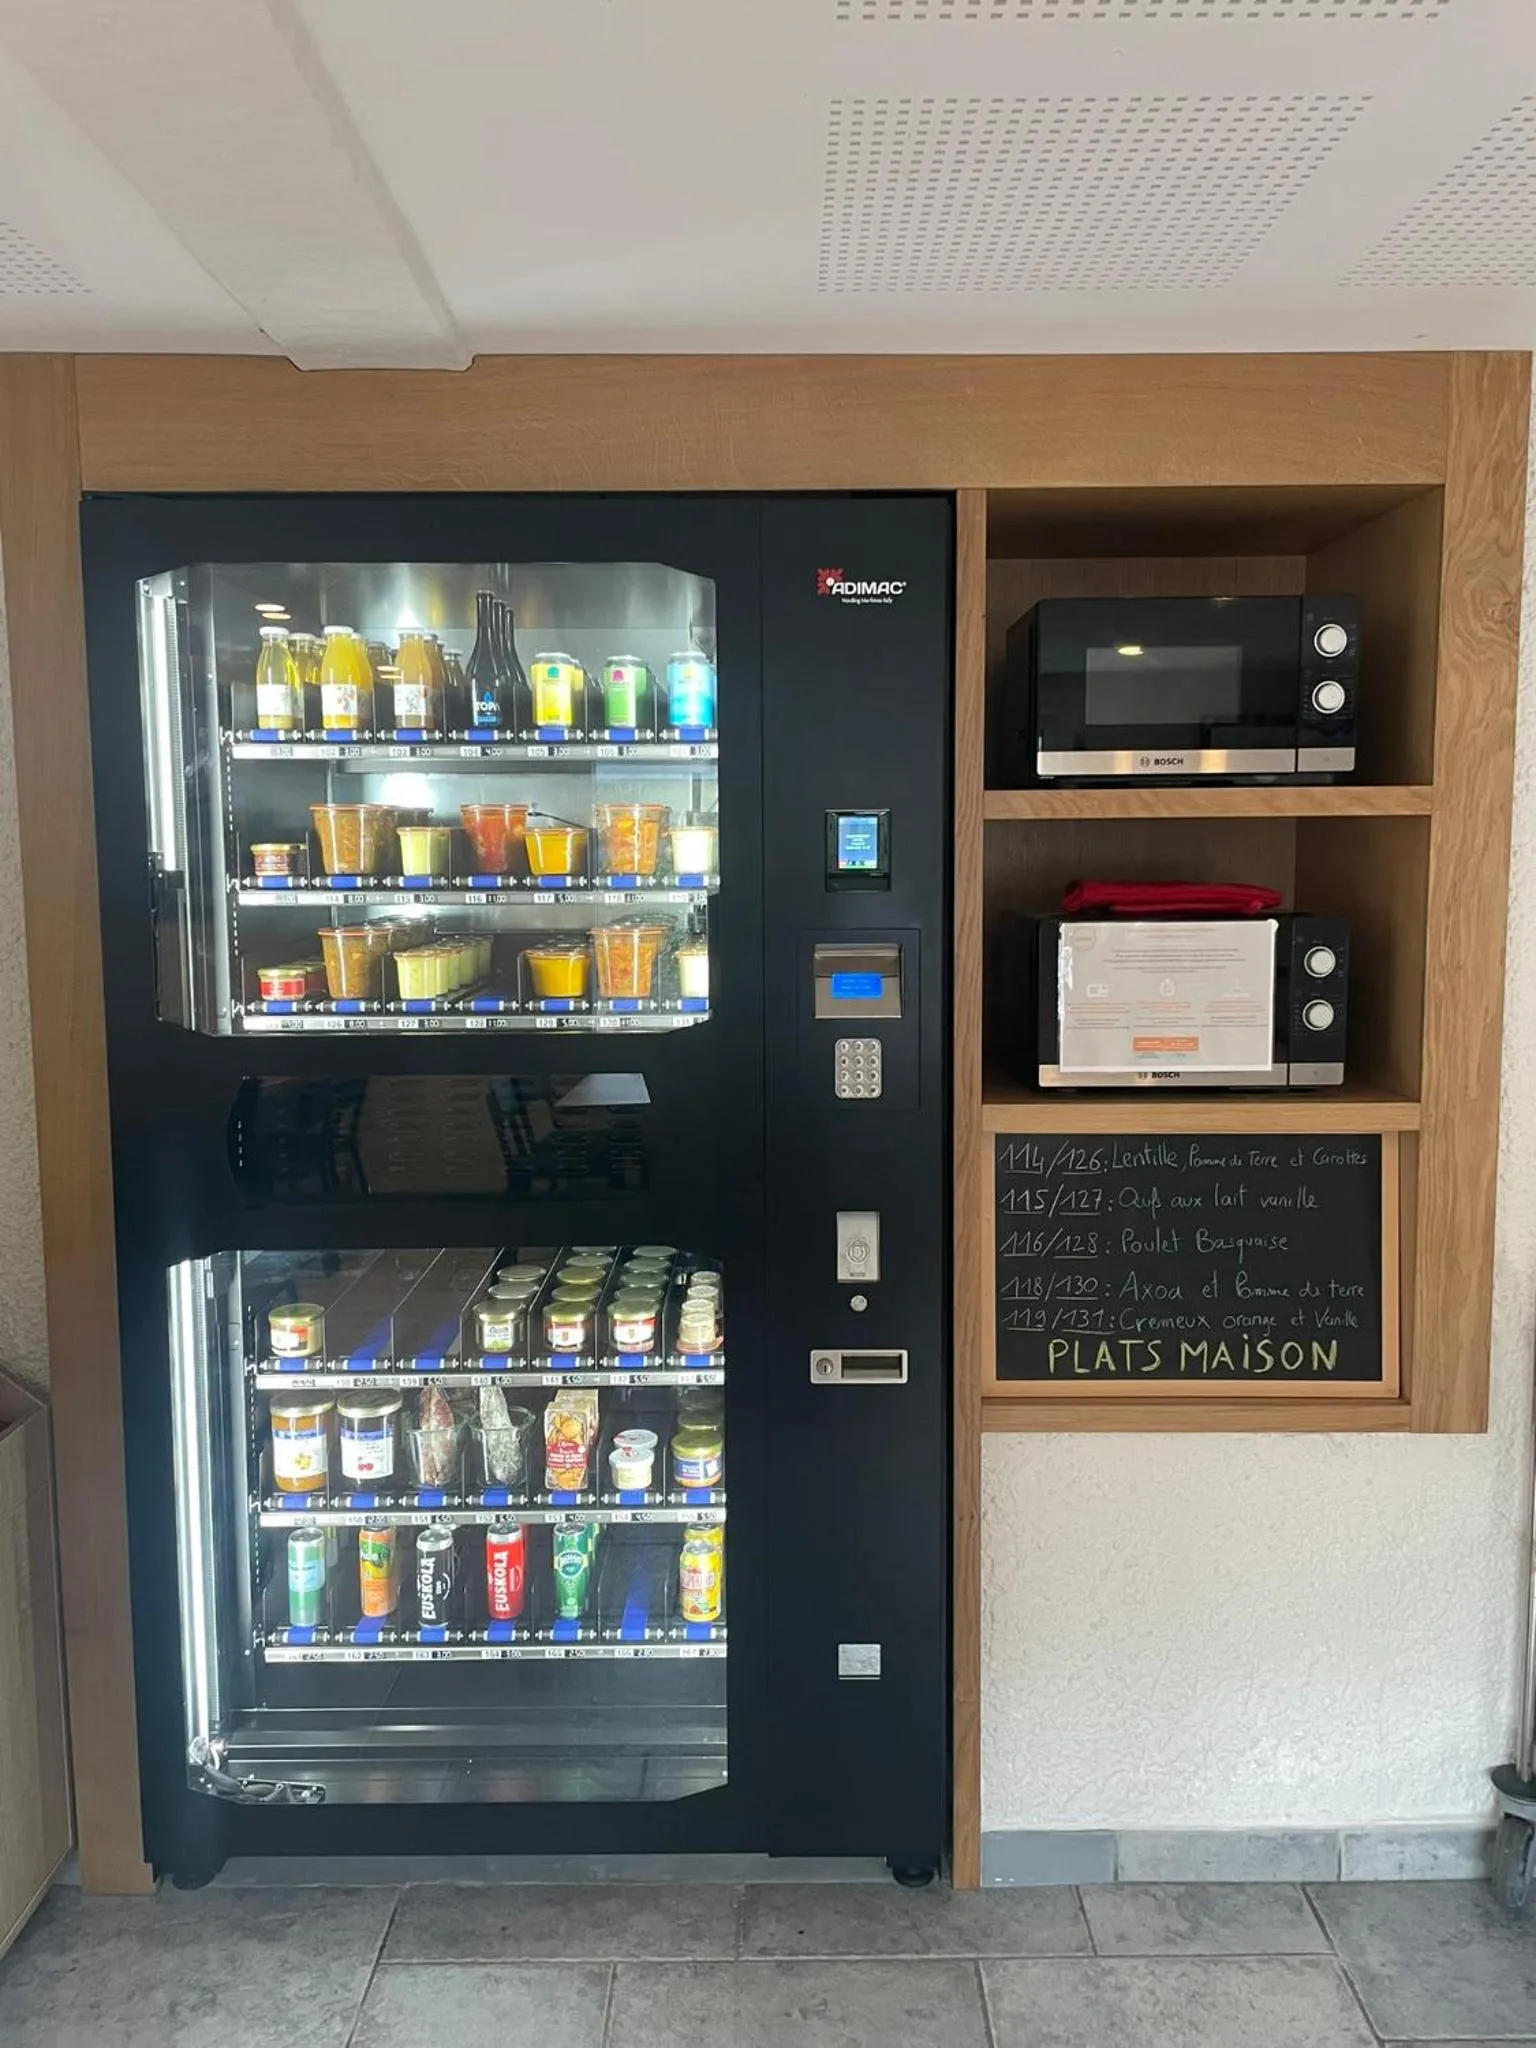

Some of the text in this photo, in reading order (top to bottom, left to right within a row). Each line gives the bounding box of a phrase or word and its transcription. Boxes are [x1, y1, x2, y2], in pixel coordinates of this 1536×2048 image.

[831, 581, 904, 595] ADIMAC
[1154, 757, 1184, 765] BOSCH
[1151, 1071, 1180, 1079] BOSCH
[1248, 1151, 1279, 1168] Terre
[1290, 1148, 1304, 1167] et
[1171, 1195, 1202, 1208] aux
[1215, 1182, 1247, 1207] lait
[1260, 1185, 1320, 1209] vanille
[1122, 1226, 1181, 1254] Poulet
[1196, 1228, 1288, 1264] Basquaise
[1119, 1271, 1183, 1301] Axoa
[1202, 1270, 1218, 1299] et
[1328, 1279, 1364, 1299] terre
[1222, 1314, 1277, 1337] orange
[1290, 1309, 1305, 1326] et
[1315, 1306, 1359, 1329] Vanille
[1049, 1338, 1163, 1374] PLATS
[420, 1557, 437, 1619] EUSKOLA
[493, 1551, 510, 1612] EUSKOLA
